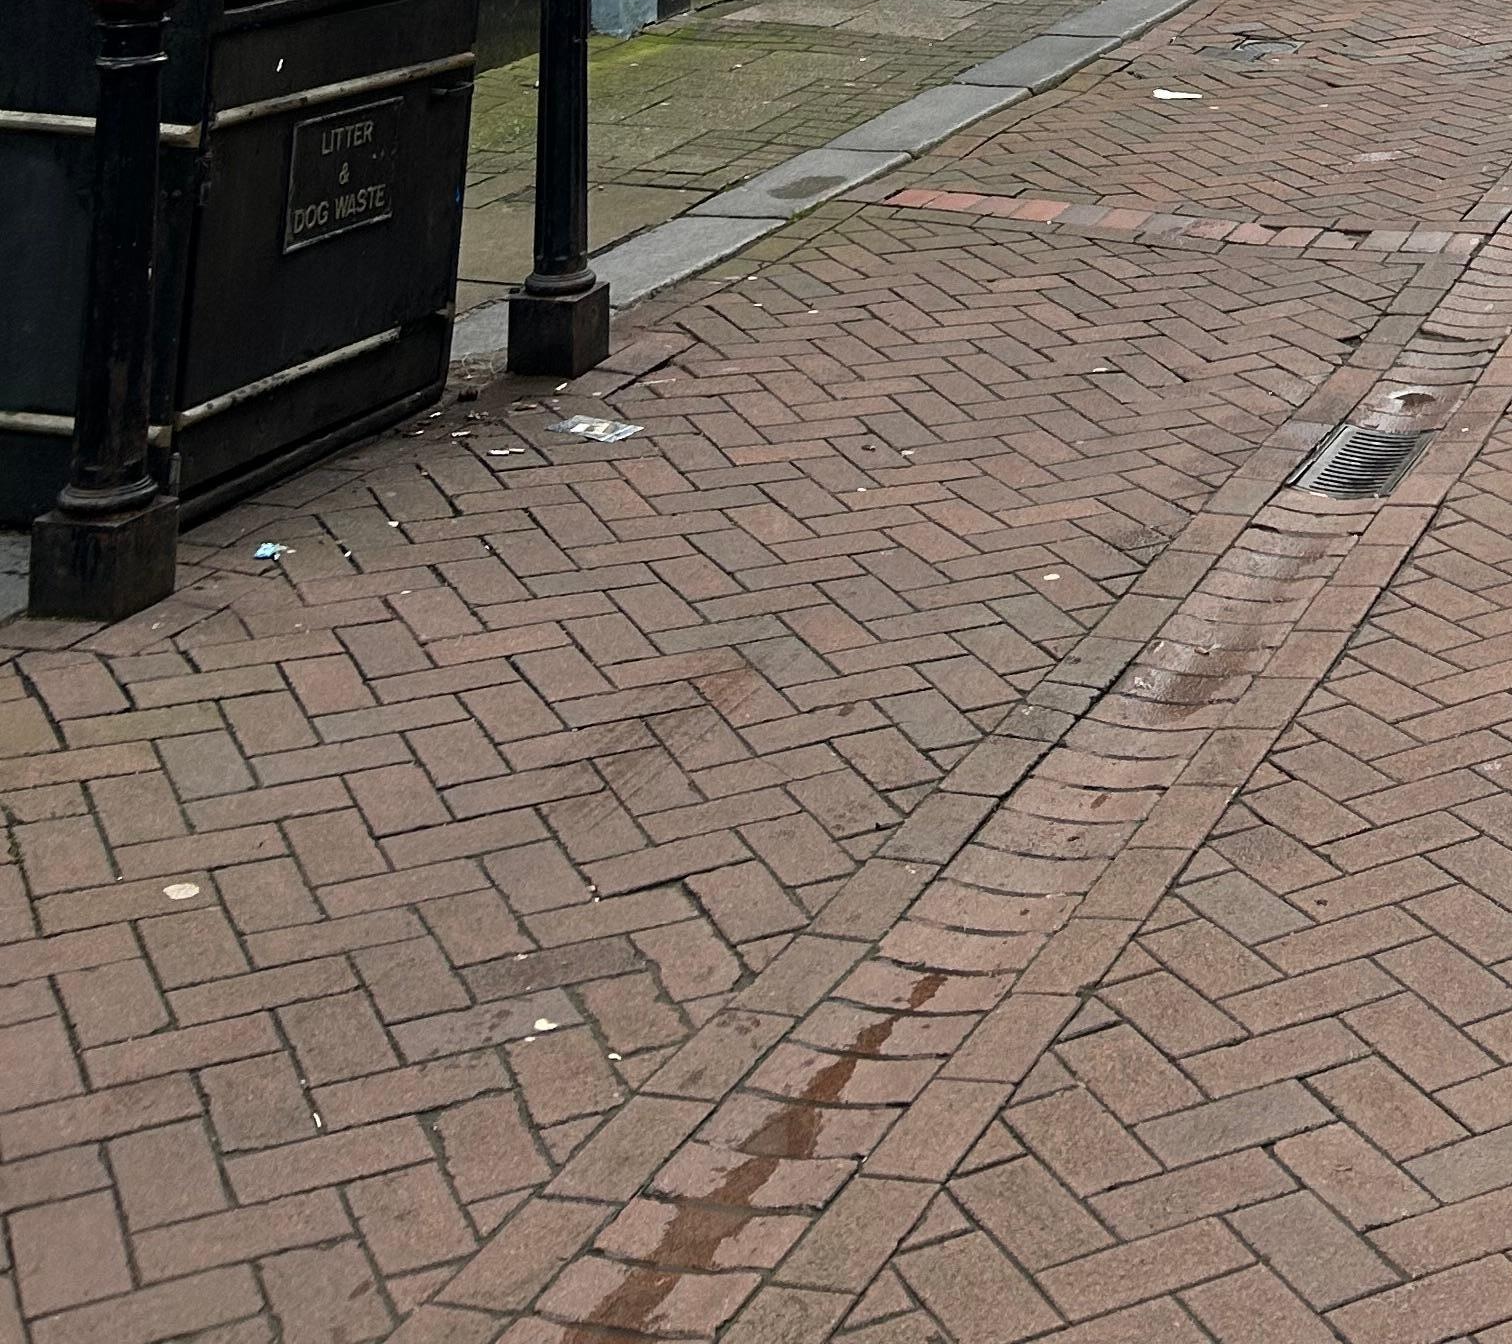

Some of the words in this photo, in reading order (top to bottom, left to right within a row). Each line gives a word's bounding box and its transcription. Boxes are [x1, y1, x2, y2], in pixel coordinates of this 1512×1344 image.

[321, 119, 374, 155] LITTER
[338, 161, 350, 185] &
[293, 200, 329, 234] DOG
[335, 183, 387, 220] WASTE
